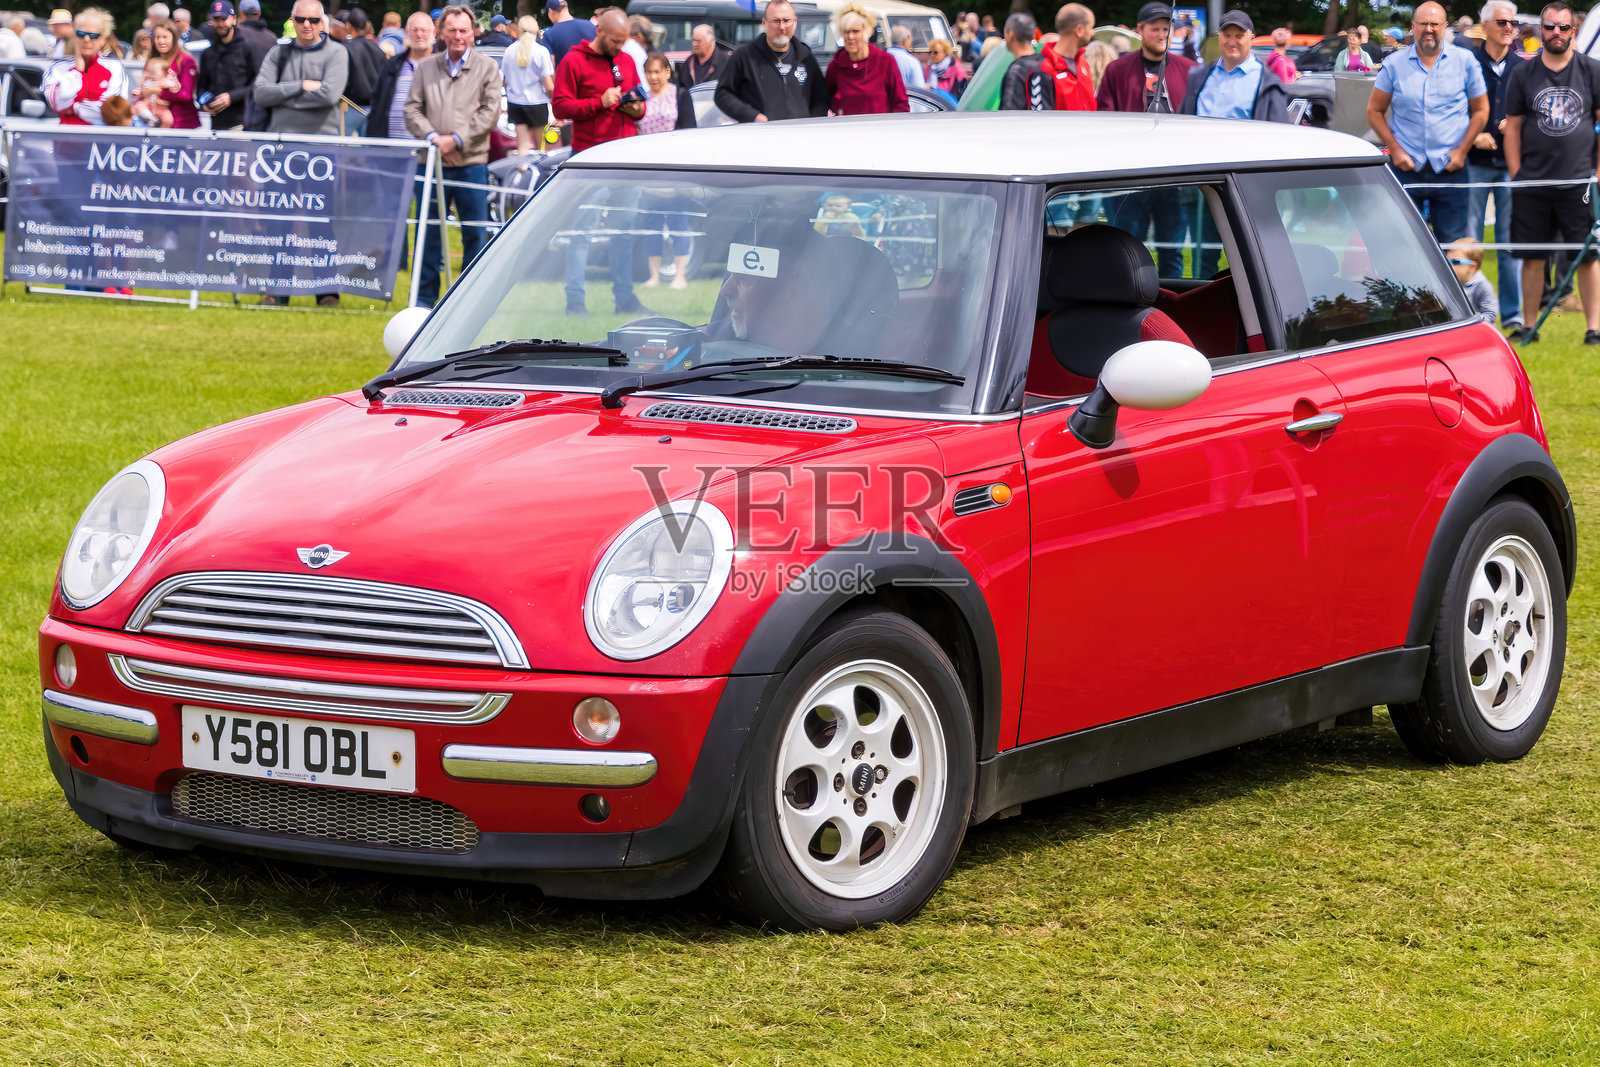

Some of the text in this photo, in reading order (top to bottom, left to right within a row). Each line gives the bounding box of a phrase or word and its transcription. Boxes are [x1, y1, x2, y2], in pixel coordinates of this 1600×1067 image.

[90, 184, 326, 211] FINANCIAL CONSULTANTS
[26, 220, 144, 243] Retirement Planning
[218, 230, 338, 252] Investment Planning
[24, 239, 166, 263] Inheritance Tax Planning
[215, 248, 377, 270] Corporate Financial Planning
[205, 714, 387, 779] Y581 OBL
[858, 767, 869, 791] MINI
